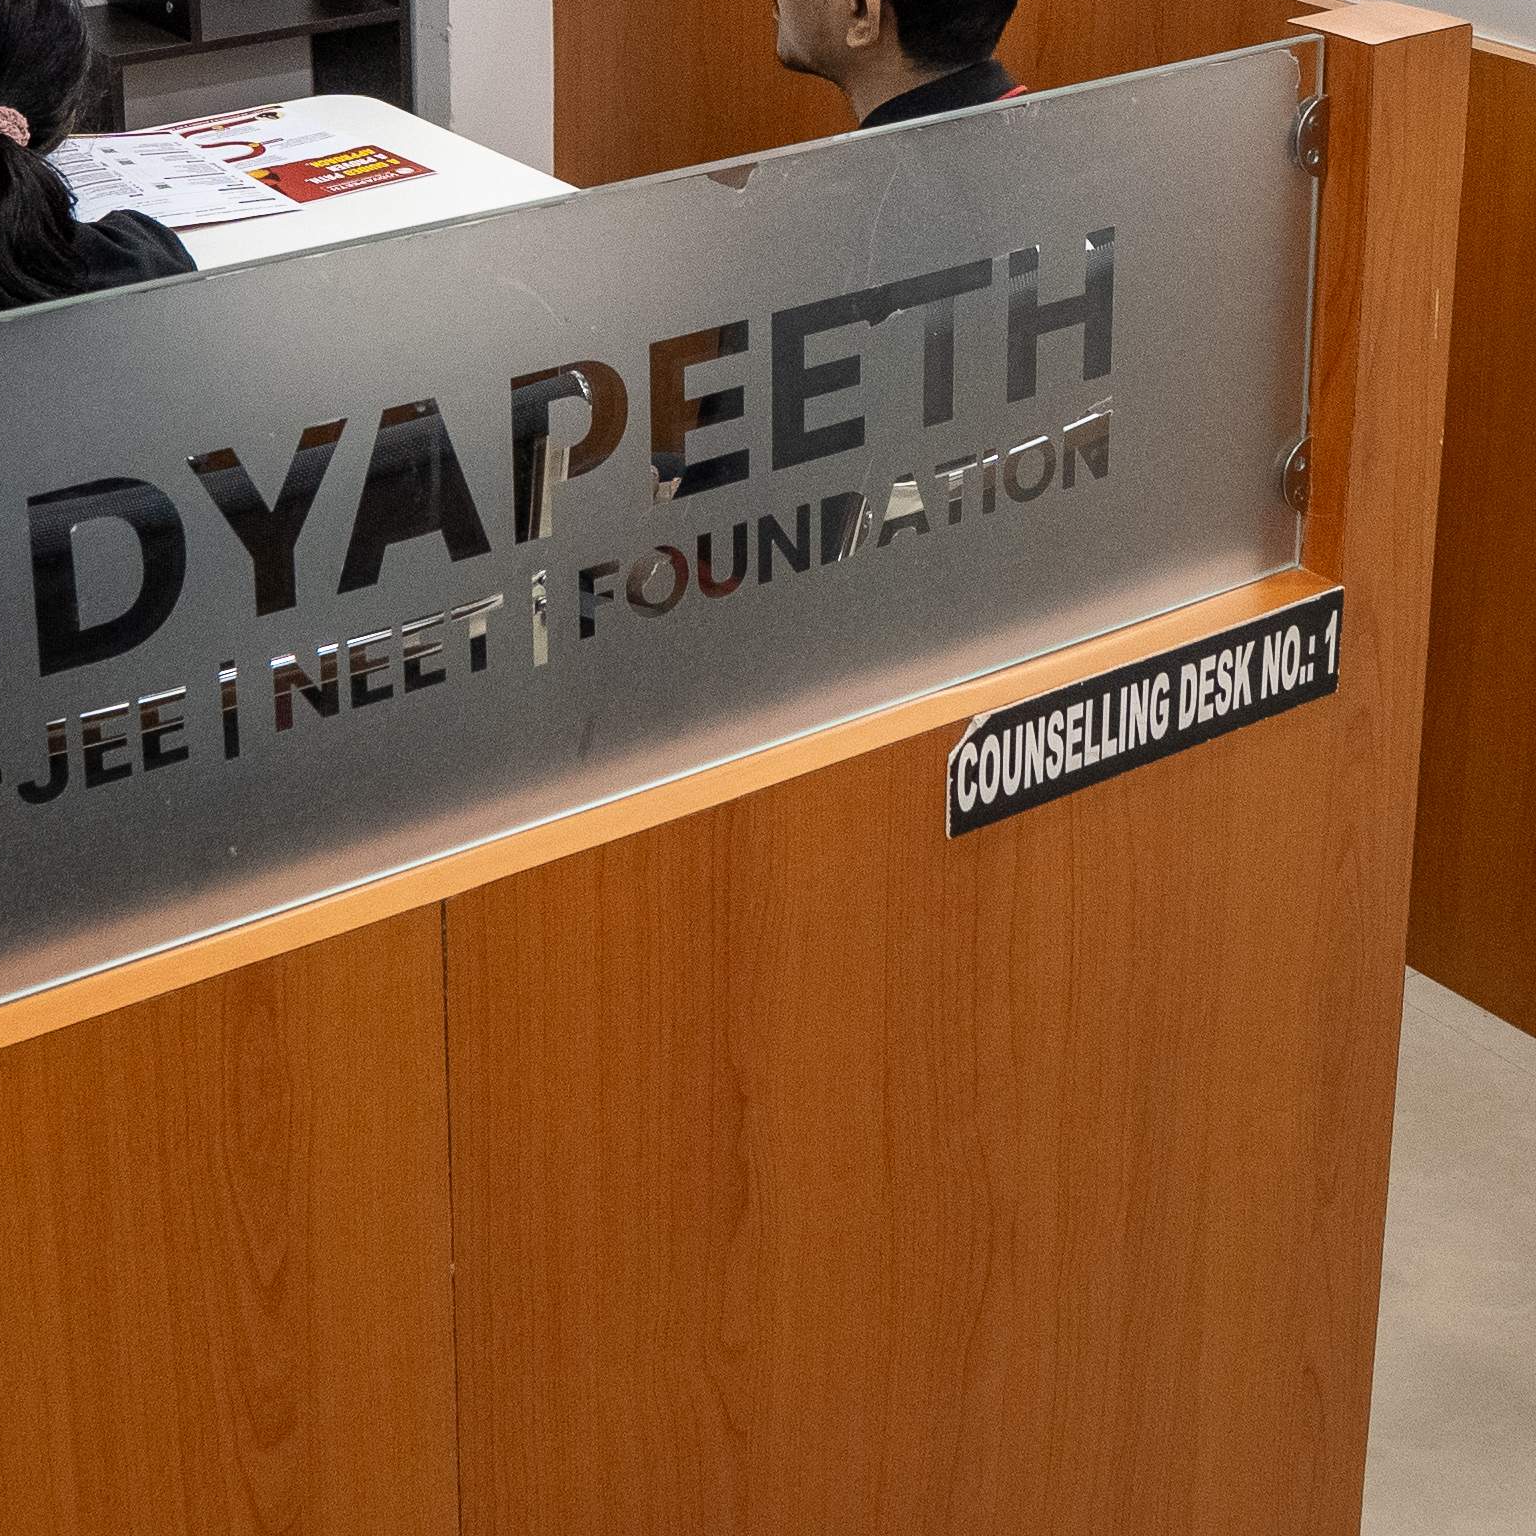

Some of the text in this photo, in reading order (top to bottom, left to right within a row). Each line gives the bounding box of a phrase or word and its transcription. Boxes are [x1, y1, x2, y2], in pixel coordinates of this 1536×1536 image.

[272, 594, 504, 733] NEET
[578, 408, 1115, 640] FOUNDATION
[957, 610, 1338, 813] COUNSELLING DESK NO.: 1
